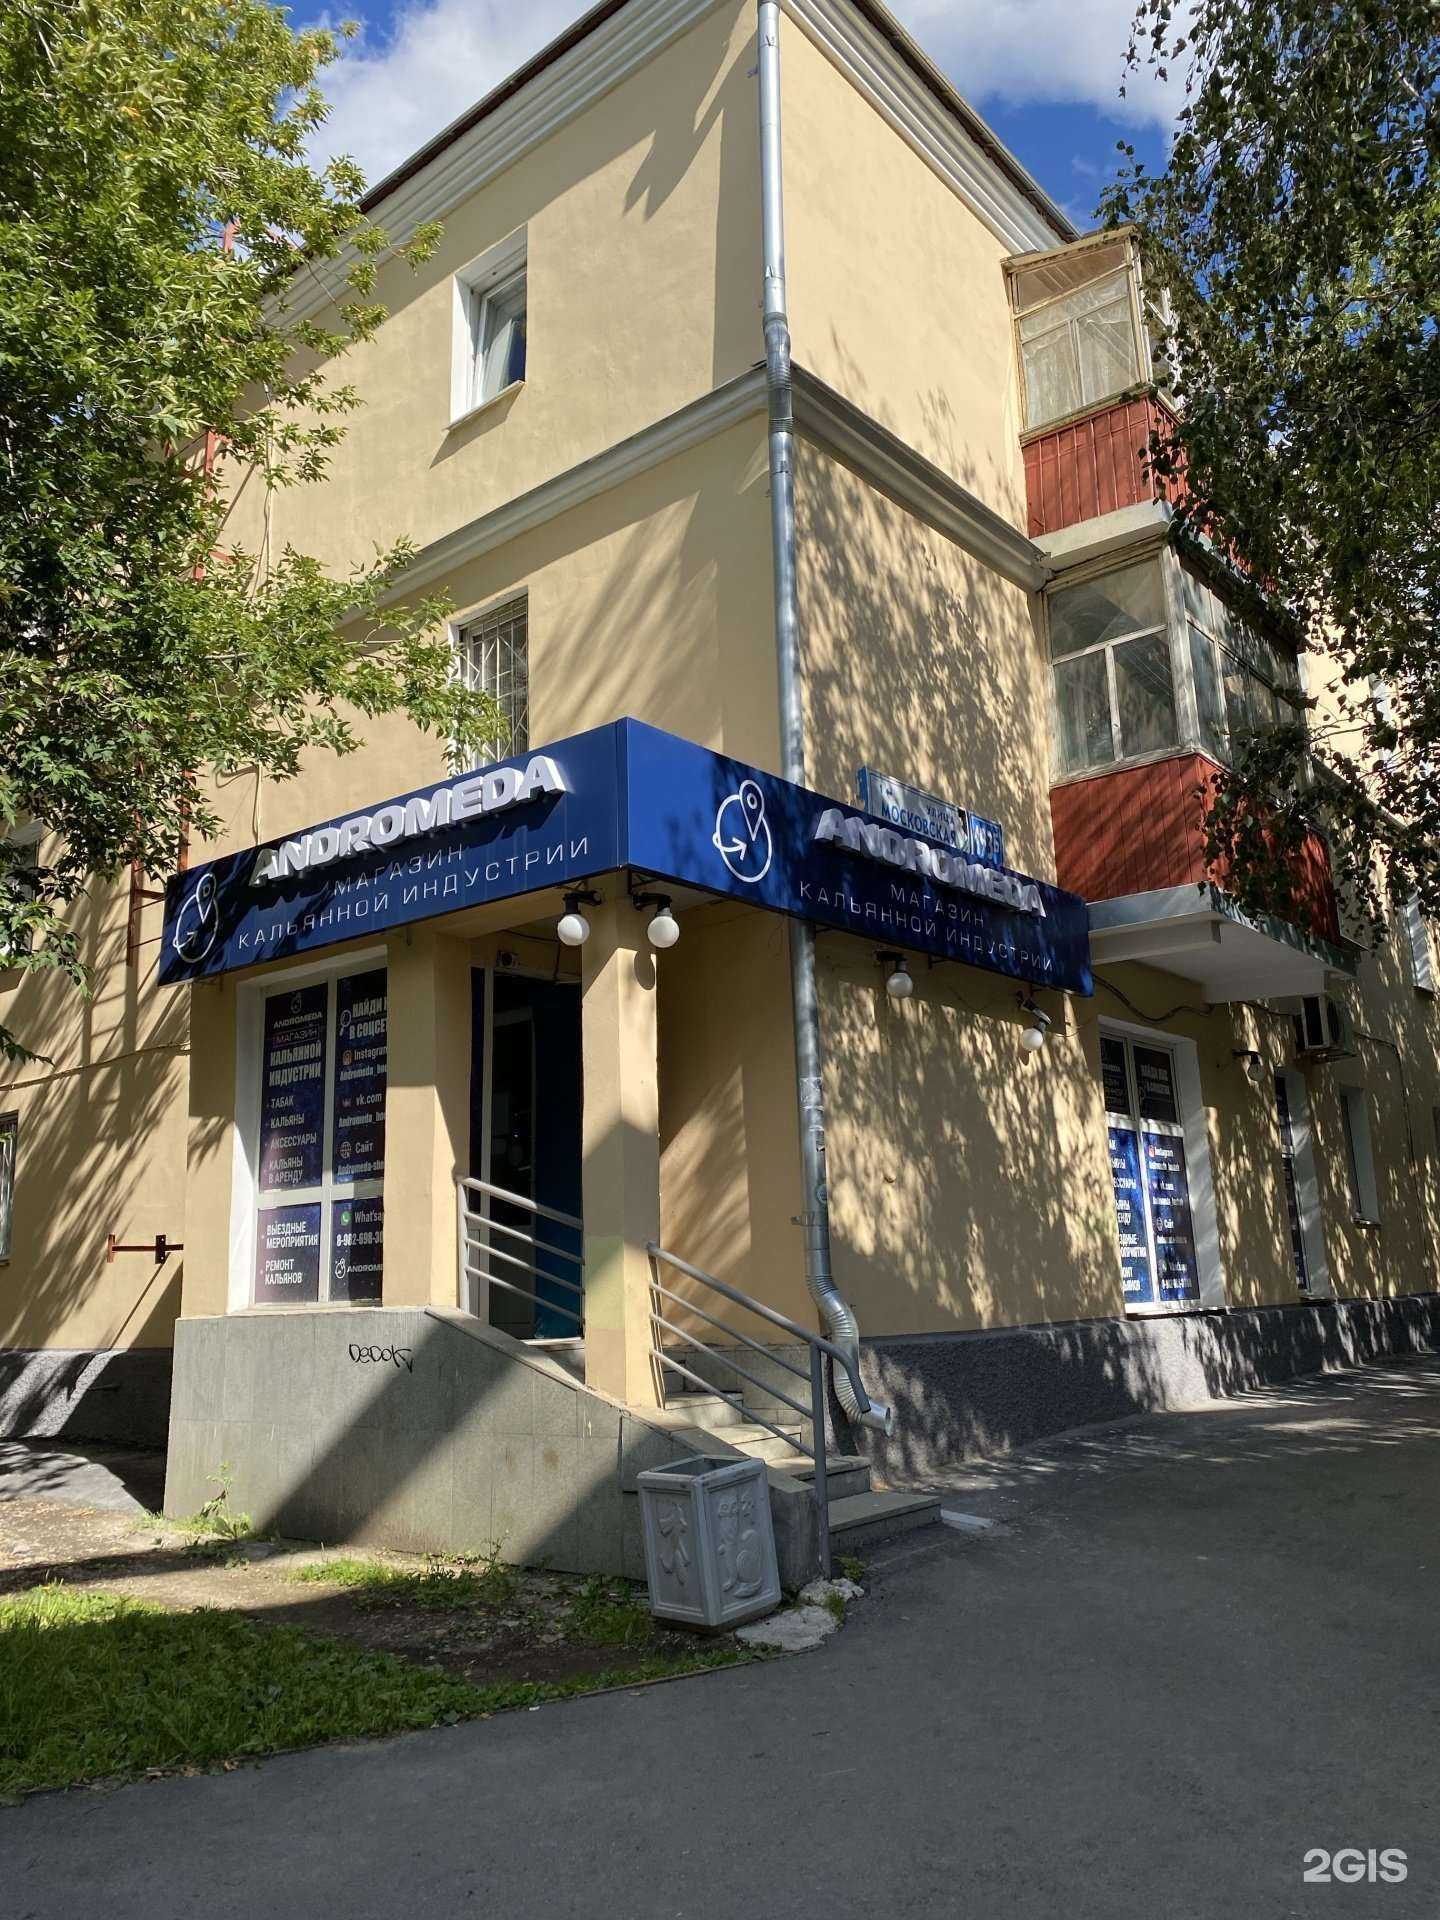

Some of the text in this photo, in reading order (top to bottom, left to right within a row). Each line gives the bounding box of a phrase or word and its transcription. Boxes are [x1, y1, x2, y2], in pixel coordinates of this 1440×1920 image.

[249, 754, 567, 887] ANDROMEDA
[881, 799, 957, 848] МОСКОВСКАЯ
[926, 804, 955, 826] УЛИЦА
[334, 844, 462, 897] МАГАЗИН
[814, 808, 1047, 918] ANDROMEDA
[238, 836, 588, 950] КАЛЬЯННОЙ ИНДУСТРИИ
[890, 883, 985, 928] МАГАЗИН
[800, 881, 1052, 971] КАЛЬЯННОЙ ИНДУСТРИИ
[352, 997, 382, 1018] НАЙДИ
[275, 1028, 318, 1043] МАГАЗИН
[349, 1024, 355, 1039] В
[270, 1040, 322, 1067] КАЛЬЯННОЙ
[269, 1061, 321, 1087] ИНДУСТРИИ
[271, 1095, 294, 1109] ТАБАК
[355, 1093, 382, 1106] vk.com
[270, 1112, 305, 1129] КАЛЬЯНЫ
[270, 1132, 317, 1150] АКСЕССУАРЫ
[355, 1140, 374, 1154] Сайт
[269, 1156, 303, 1170] КАЛЬЯНЫ
[268, 1169, 303, 1185] В АРЕНДУ
[266, 1221, 307, 1237] ВЫЕЗДНЫЕ
[266, 1234, 319, 1249] МЕРОПРИЯТИЯ
[265, 1258, 295, 1272] РЕМОНТ
[264, 1271, 303, 1285] КАЛЬЯНОВ
